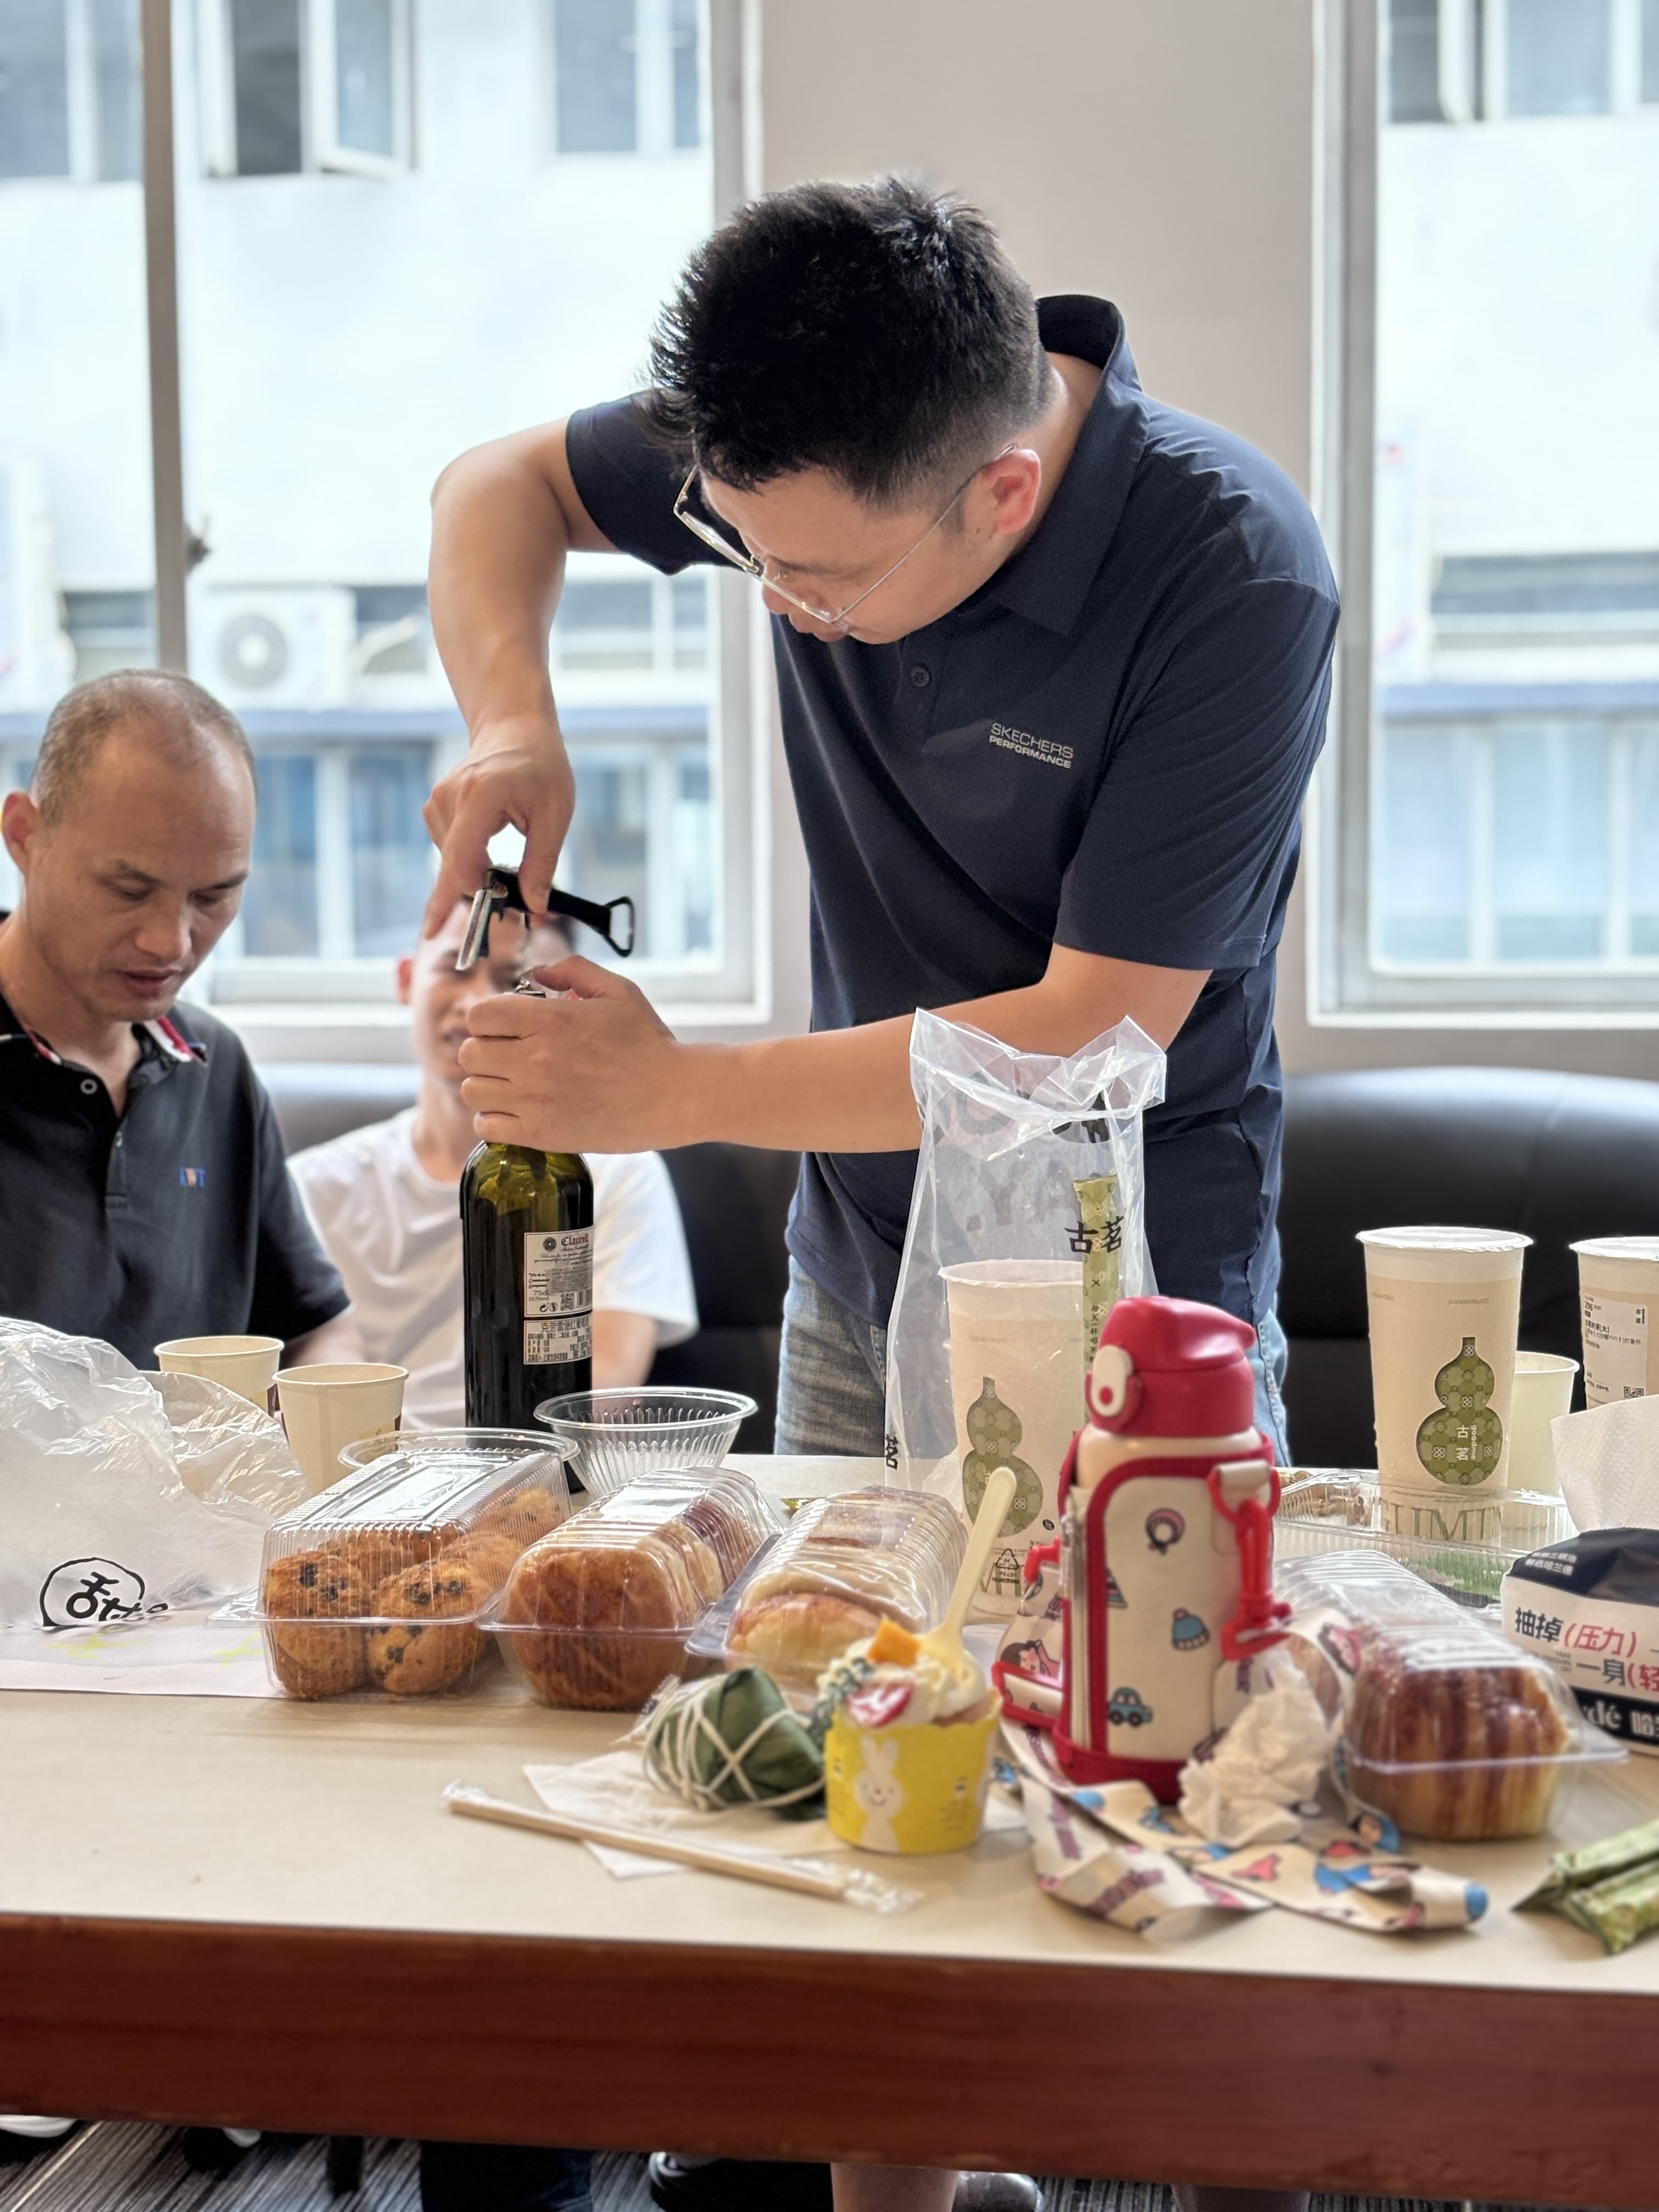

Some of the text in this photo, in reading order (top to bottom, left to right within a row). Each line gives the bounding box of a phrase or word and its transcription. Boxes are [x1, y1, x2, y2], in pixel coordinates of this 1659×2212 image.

[989, 735, 1071, 769] PERFORMANCE
[990, 723, 1074, 759] SKECHERS
[1064, 1216, 1124, 1254] 古茗
[1455, 1425, 1470, 1460] 古茗
[1515, 1606, 1637, 1658] 抽掉(压力)
[1583, 1700, 1621, 1729] dé
[1631, 1711, 1659, 1738] 哈
